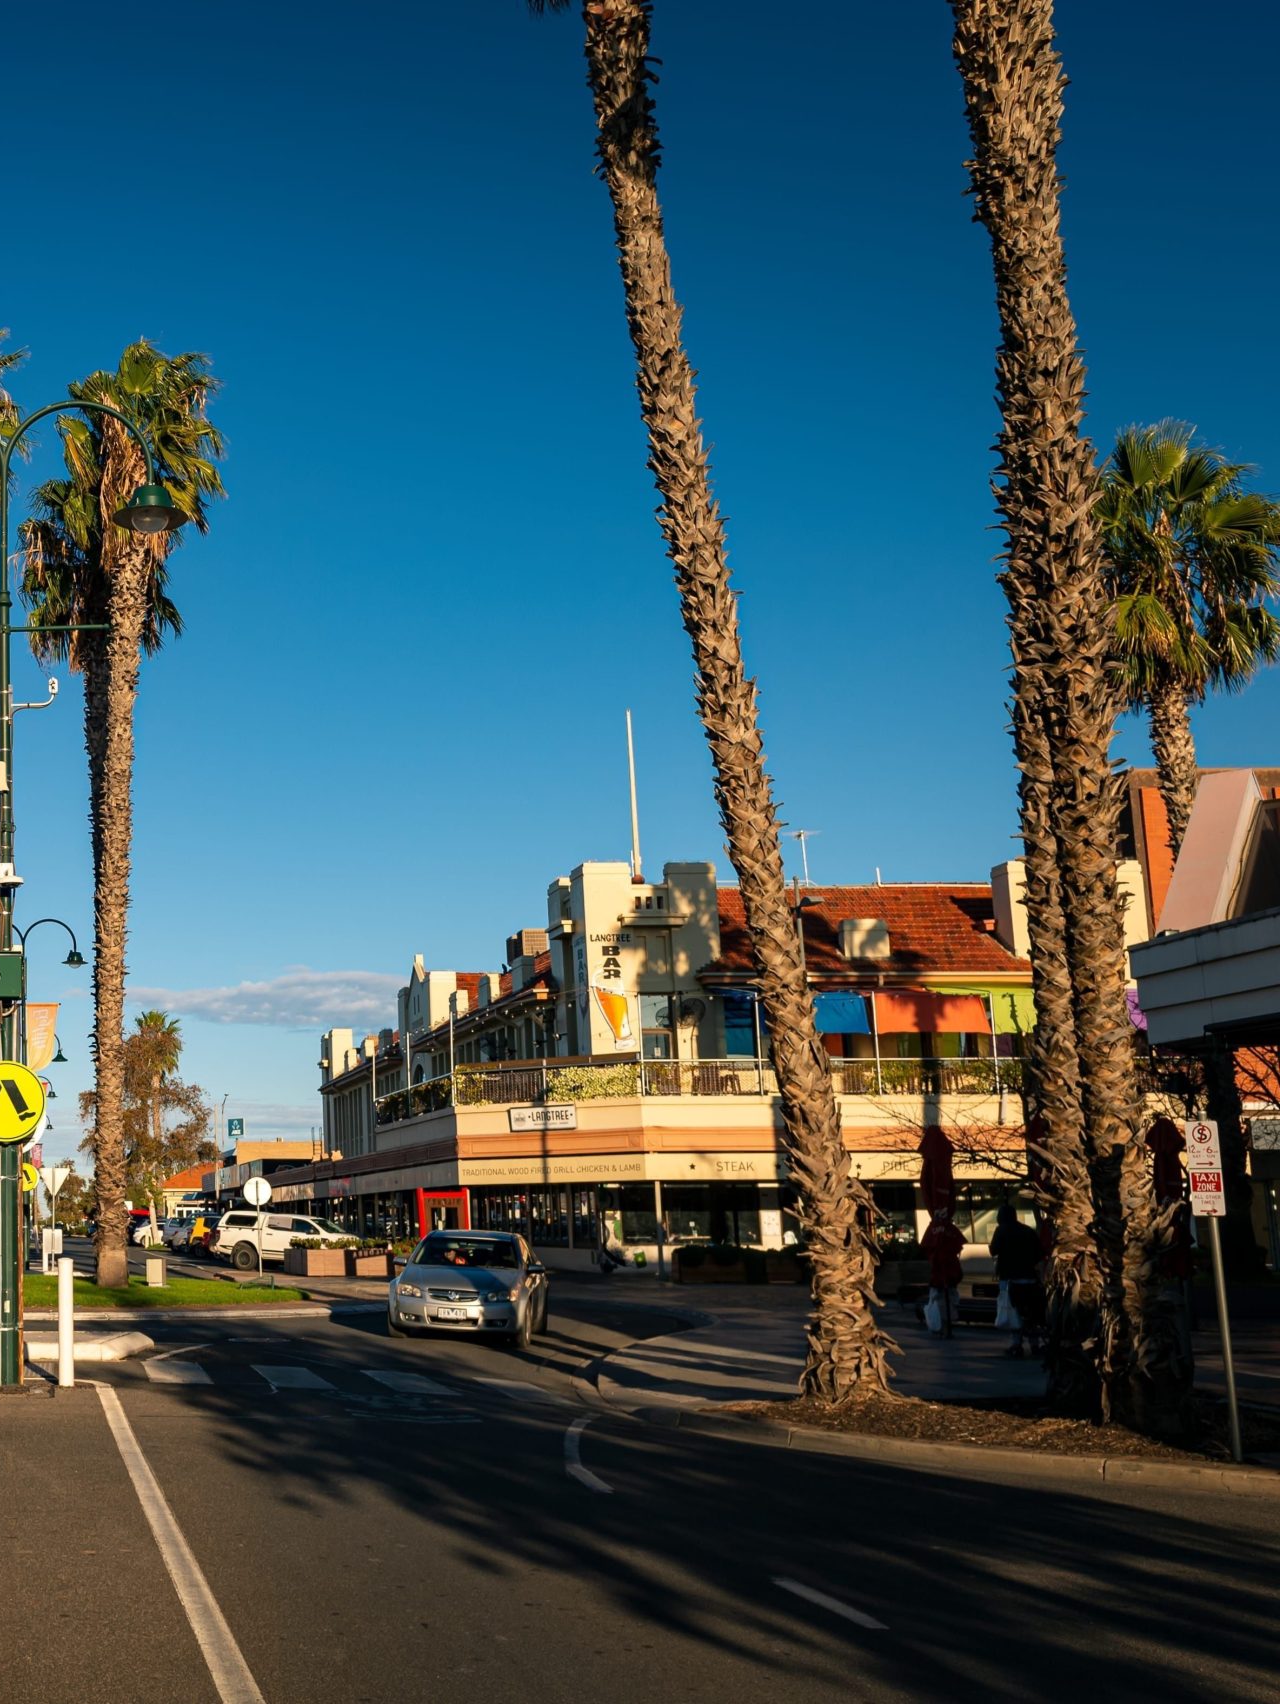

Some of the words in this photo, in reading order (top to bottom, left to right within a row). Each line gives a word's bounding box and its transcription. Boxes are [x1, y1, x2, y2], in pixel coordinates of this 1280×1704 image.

[589, 933, 631, 943] LANGTREE
[601, 945, 622, 980] BAR
[531, 1110, 569, 1122] LANGTREE
[462, 1167, 507, 1177] TRADITIONAL
[508, 1166, 529, 1176] WOOD
[530, 1166, 552, 1175] FIRED
[553, 1165, 575, 1175] GRILL
[576, 1164, 610, 1173] CHICKEN
[611, 1164, 617, 1172] &
[619, 1163, 641, 1172] LAMB
[716, 1161, 755, 1173] STEAK
[882, 1161, 910, 1172] PIDE
[1194, 1173, 1218, 1182] TAXI
[1196, 1183, 1217, 1192] ZONE
